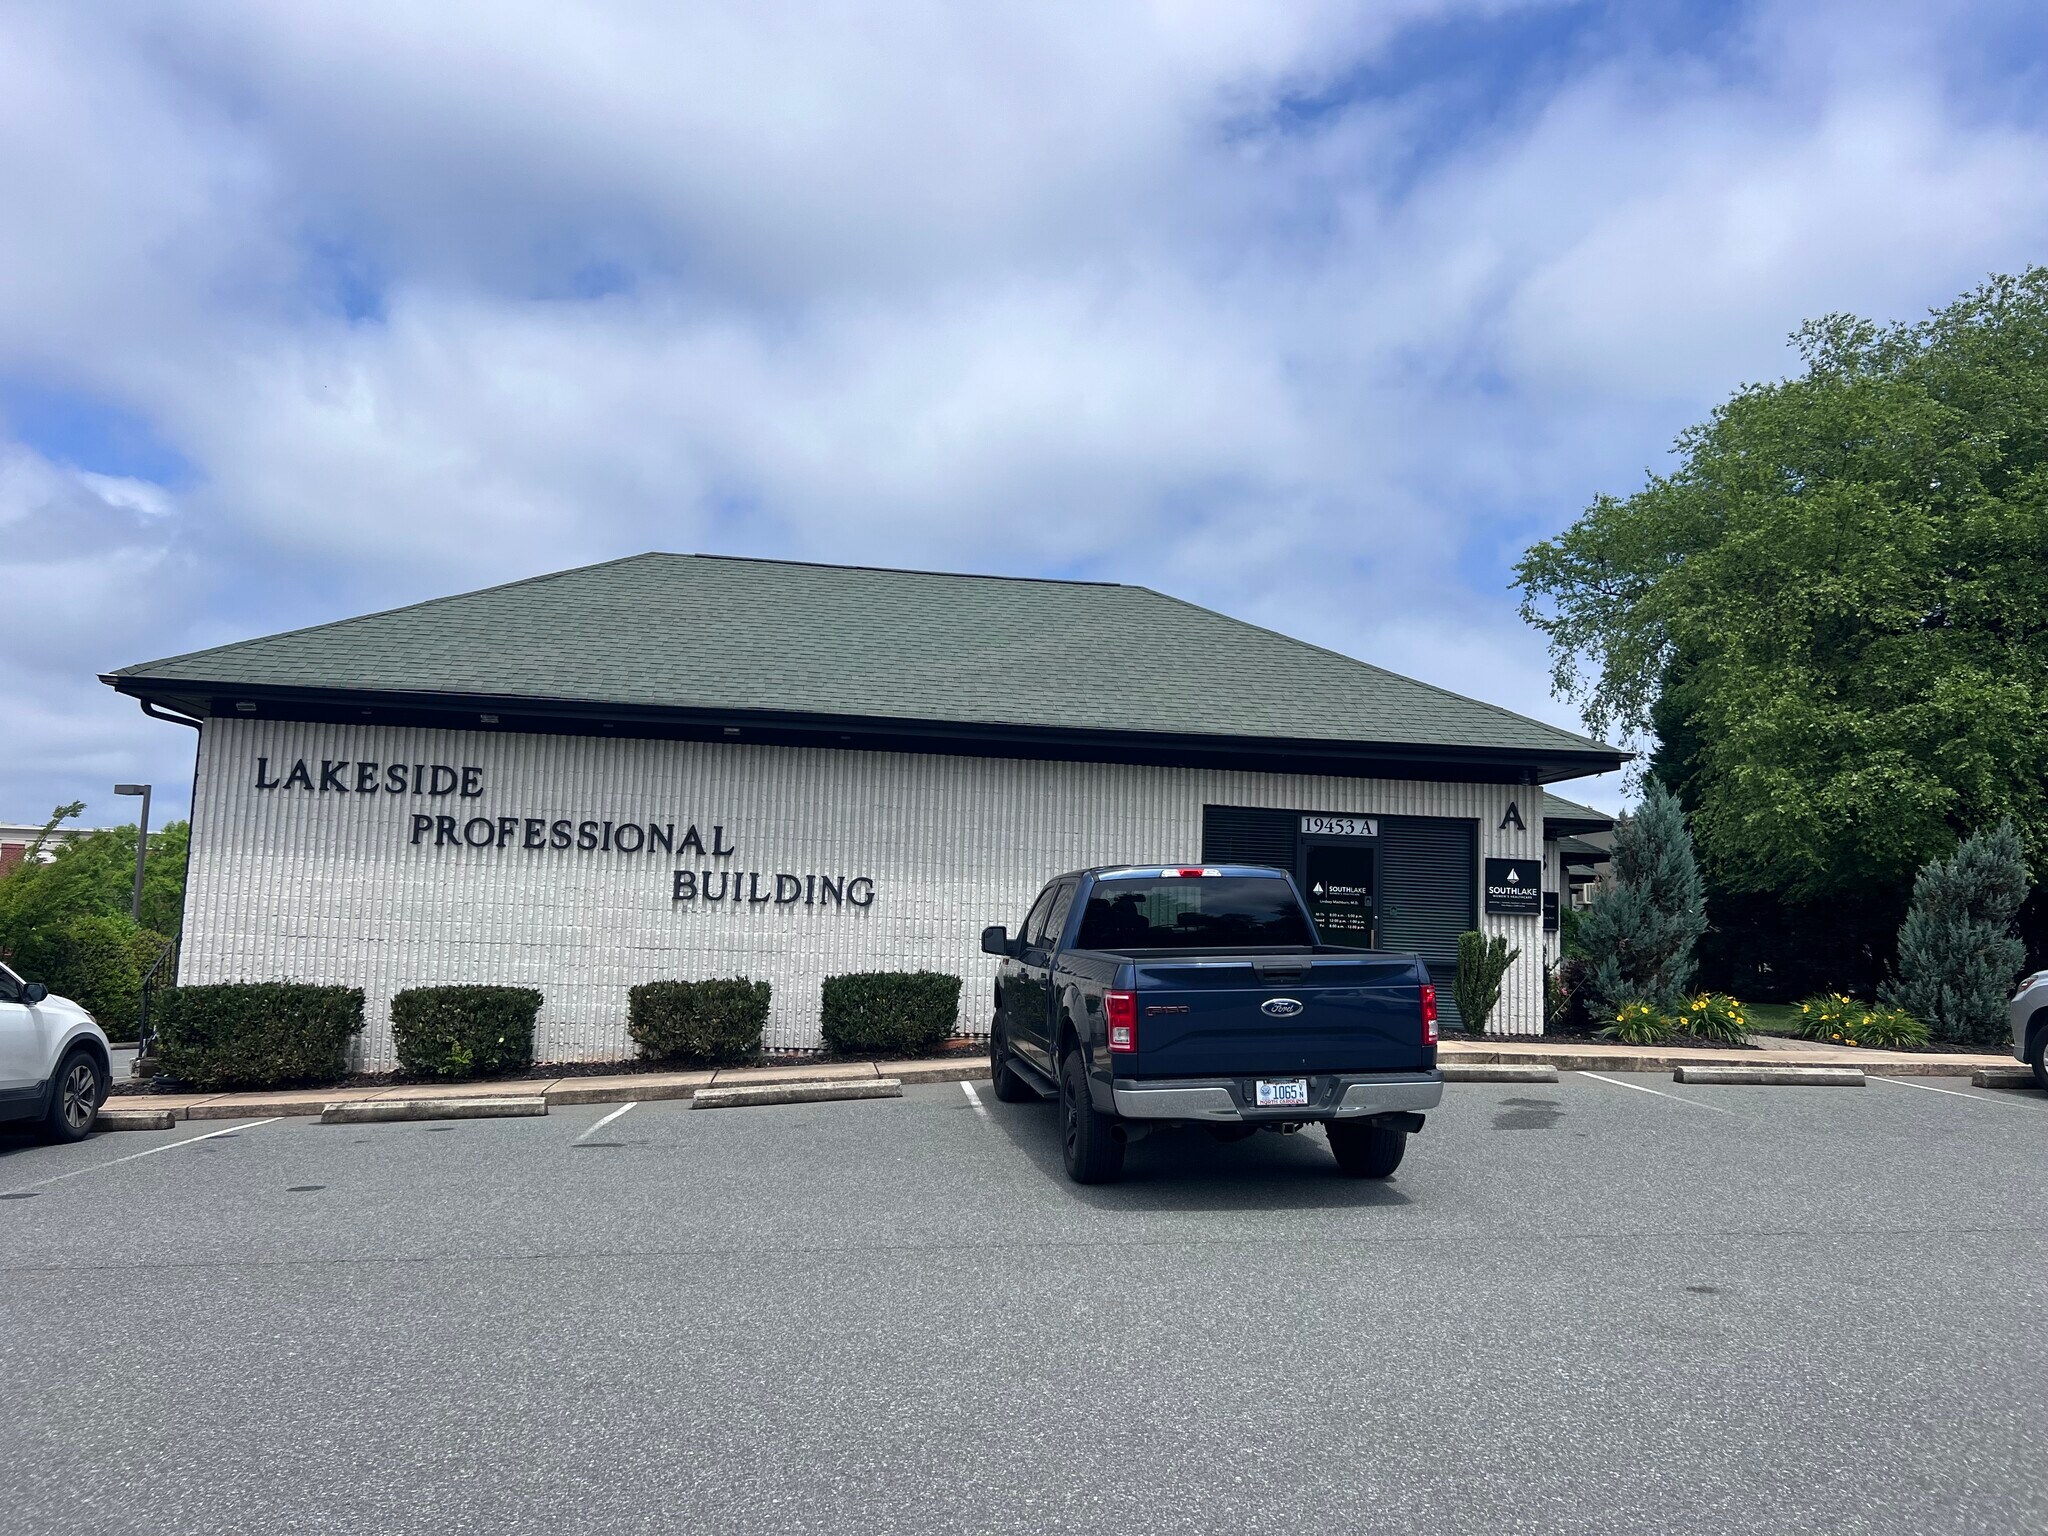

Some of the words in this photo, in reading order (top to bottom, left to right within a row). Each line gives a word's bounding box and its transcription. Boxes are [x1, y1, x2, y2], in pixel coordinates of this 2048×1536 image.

[255, 757, 484, 797] LAKESIDE
[1499, 801, 1526, 830] A
[410, 814, 735, 856] PROFESSIONAL
[1305, 817, 1355, 835] 19453
[1359, 820, 1373, 835] A
[672, 870, 876, 906] BUILDING
[1328, 886, 1367, 894] SOUTHLAKE
[1488, 886, 1537, 896] SOUTHLAKE
[1271, 1004, 1294, 1013] Ford
[1273, 1085, 1297, 1100] 1065
